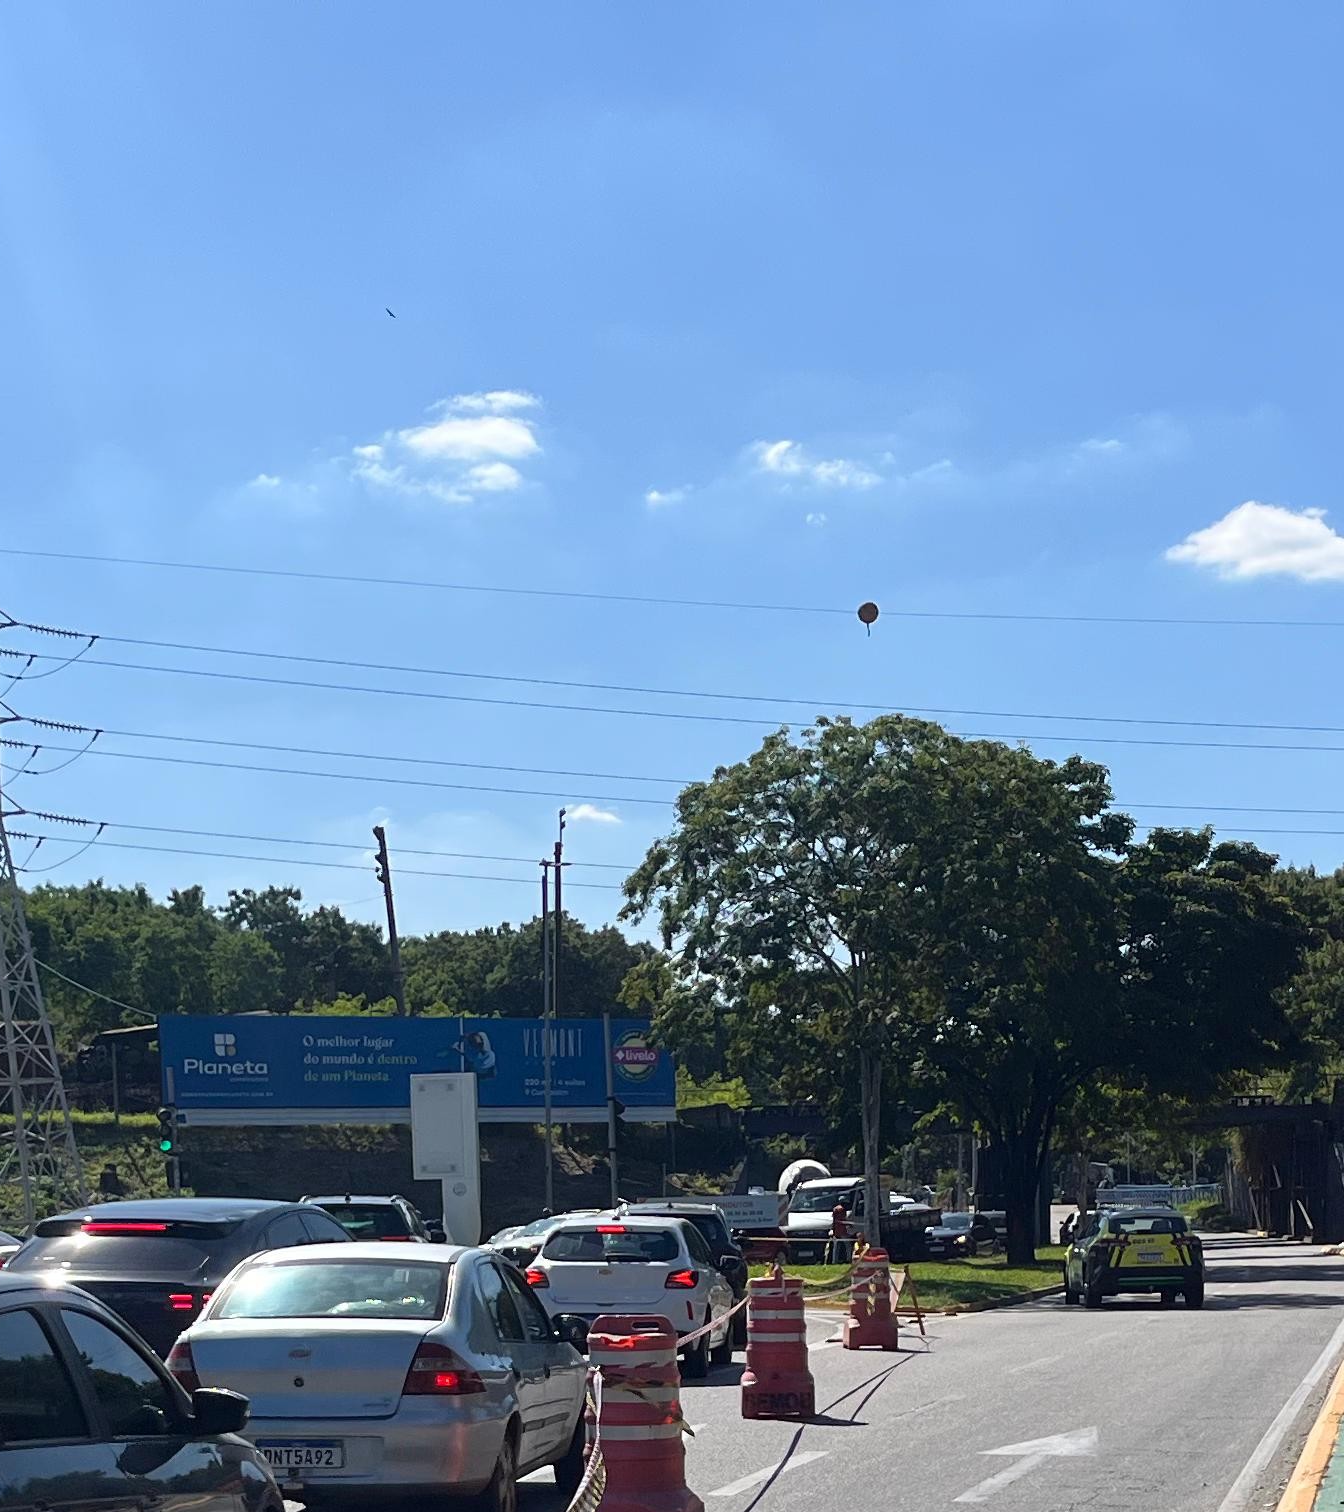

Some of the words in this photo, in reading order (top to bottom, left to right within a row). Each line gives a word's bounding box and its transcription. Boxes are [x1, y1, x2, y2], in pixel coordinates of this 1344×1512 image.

[303, 1035, 314, 1047] O
[317, 1035, 362, 1047] melhor
[363, 1035, 395, 1050] lugar
[303, 1053, 320, 1064] do
[322, 1053, 365, 1065] mundo
[367, 1053, 375, 1065] é
[377, 1053, 418, 1065] dentro
[184, 1058, 268, 1075] Planeta
[304, 1070, 319, 1082] de
[322, 1072, 341, 1082] um
